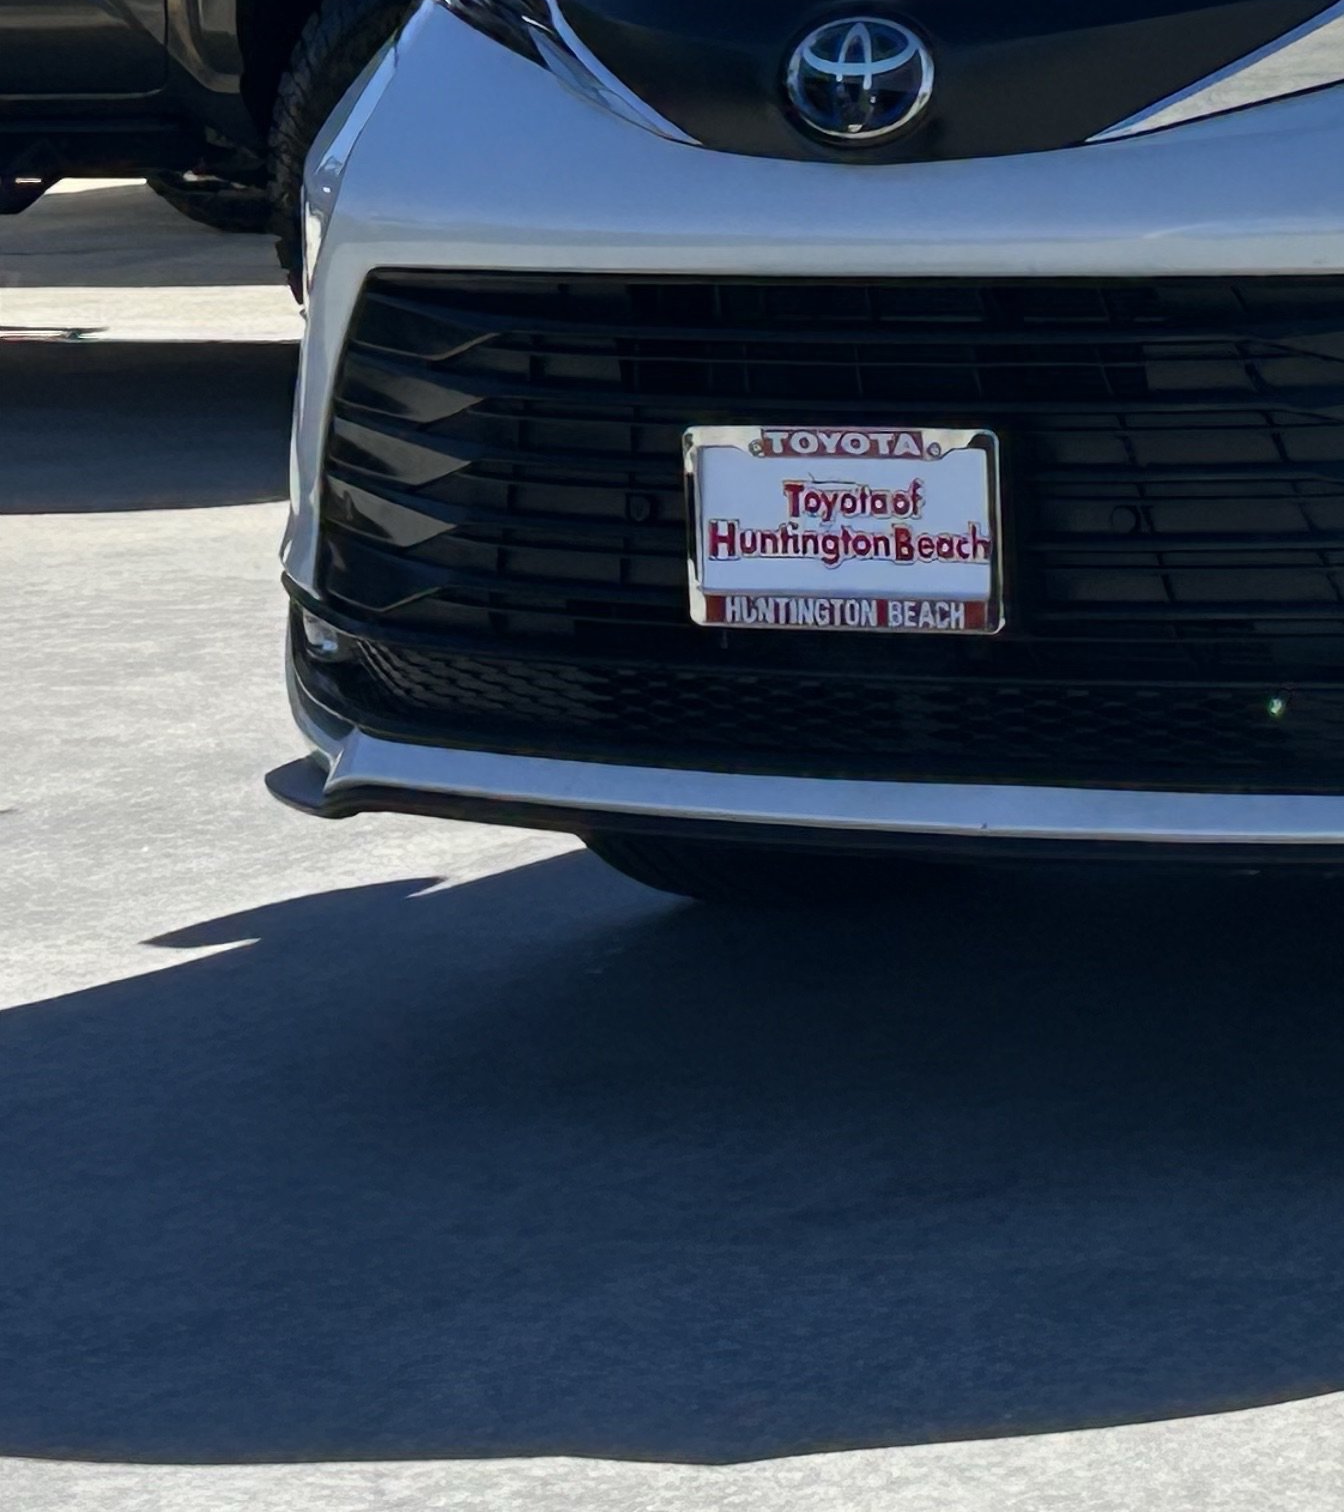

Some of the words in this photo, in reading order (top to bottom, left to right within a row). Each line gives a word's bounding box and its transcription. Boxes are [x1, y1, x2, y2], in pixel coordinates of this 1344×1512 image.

[764, 431, 923, 457] TOYOTA
[783, 478, 892, 523] Toyota
[893, 478, 924, 519] of
[708, 520, 893, 567] Huntington
[892, 522, 992, 564] Beach
[725, 596, 877, 627] HUNTINGTON
[887, 599, 965, 630] BEACH
